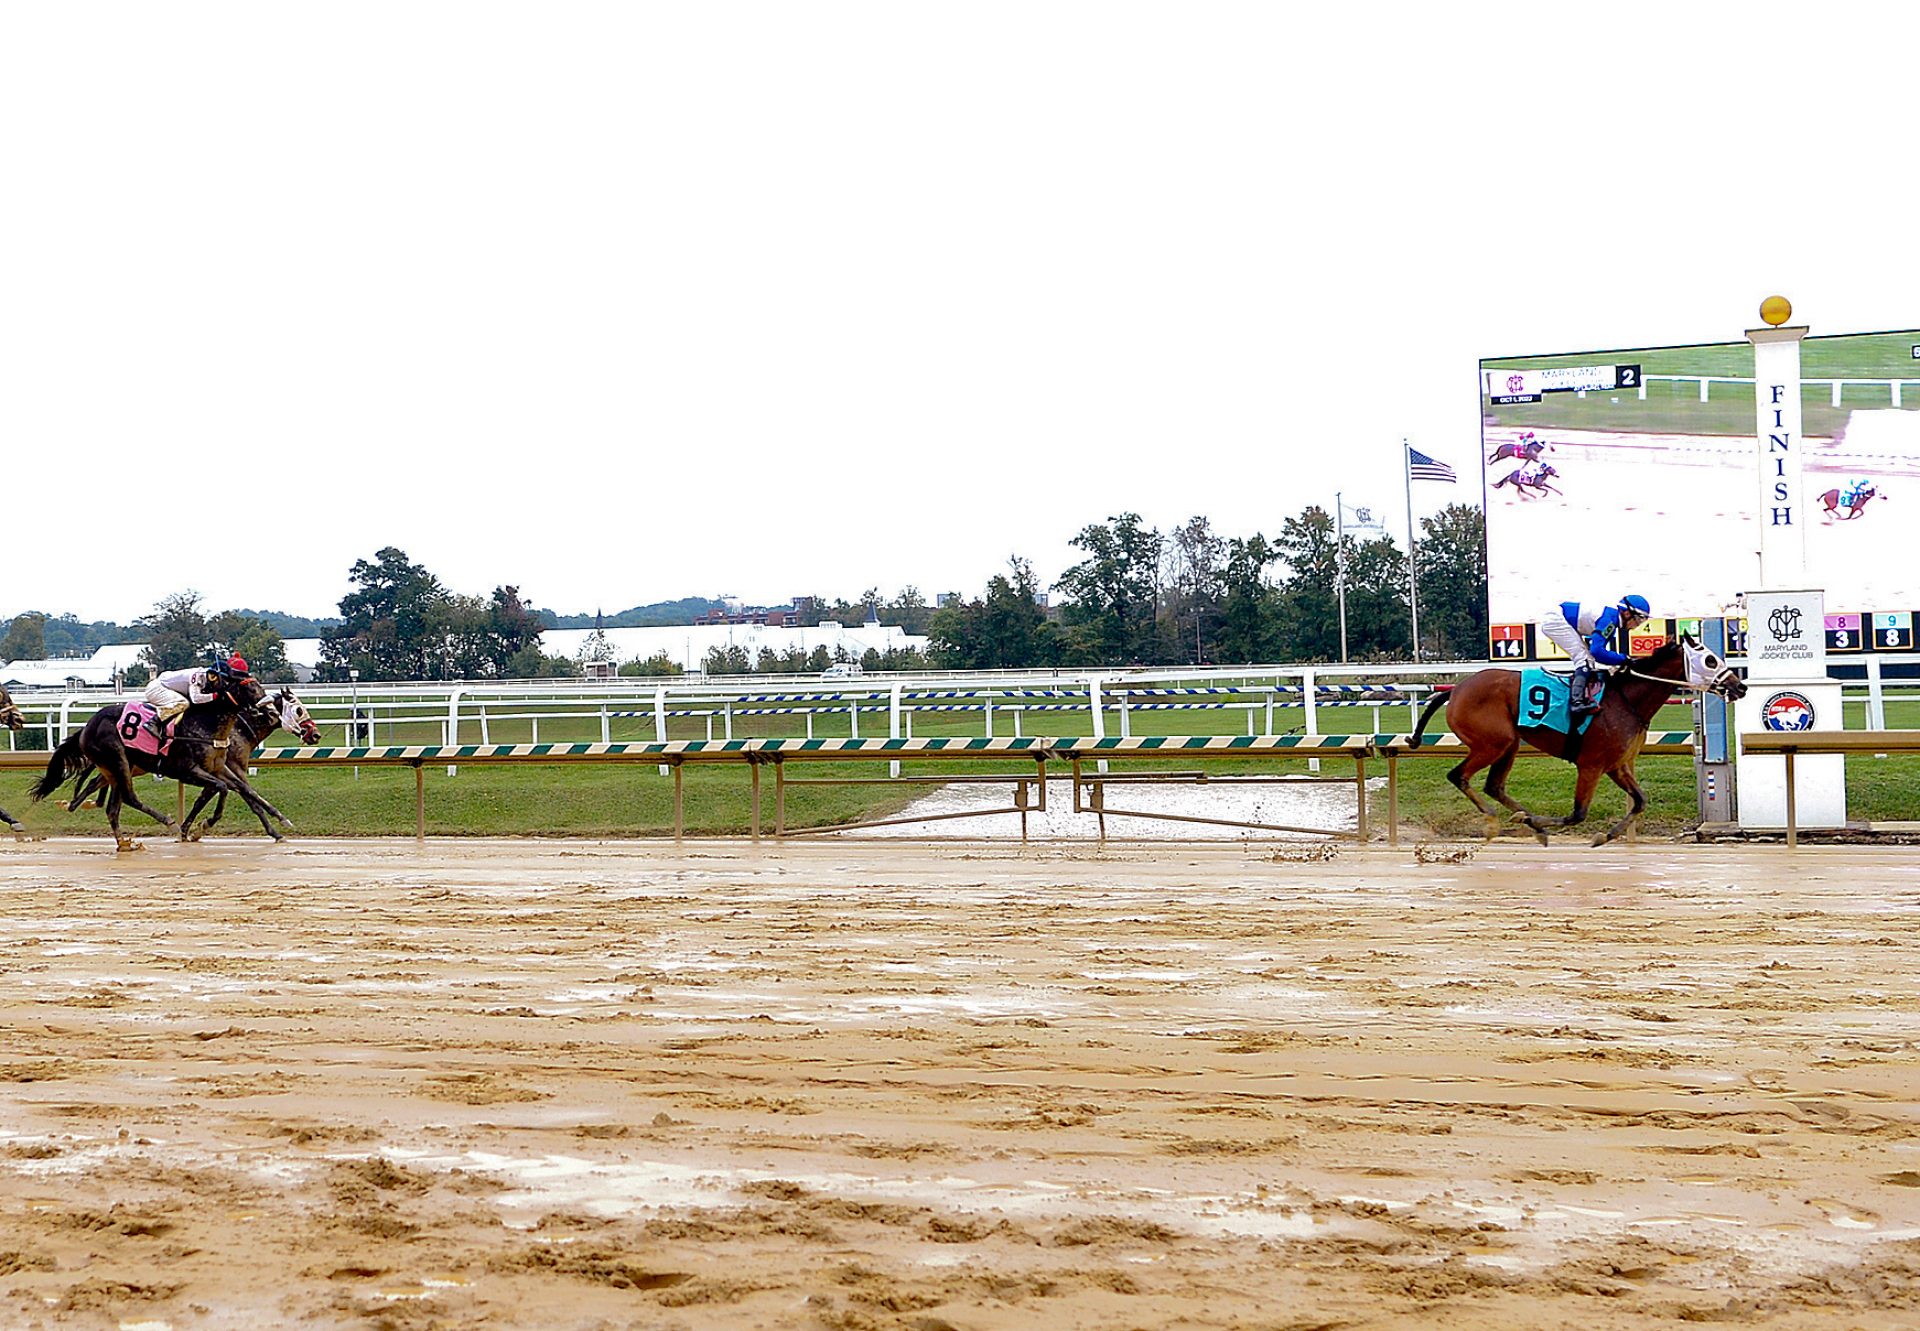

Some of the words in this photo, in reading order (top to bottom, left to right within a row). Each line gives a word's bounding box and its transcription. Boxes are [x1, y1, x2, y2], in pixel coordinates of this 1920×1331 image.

[1622, 369, 1635, 385] 2
[1768, 385, 1793, 526] FINISH
[1643, 623, 1651, 633] 4
[1838, 617, 1846, 627] 8
[1888, 615, 1896, 626] 9
[1503, 626, 1511, 639] 1
[1835, 631, 1848, 647] 3
[1886, 629, 1899, 646] 8
[1496, 640, 1521, 657] 14
[1759, 651, 1791, 660] JOCKEY
[1791, 651, 1814, 660] CLUB
[1764, 644, 1808, 652] MARYLAND
[1527, 685, 1551, 720] 9
[121, 712, 141, 740] 8
